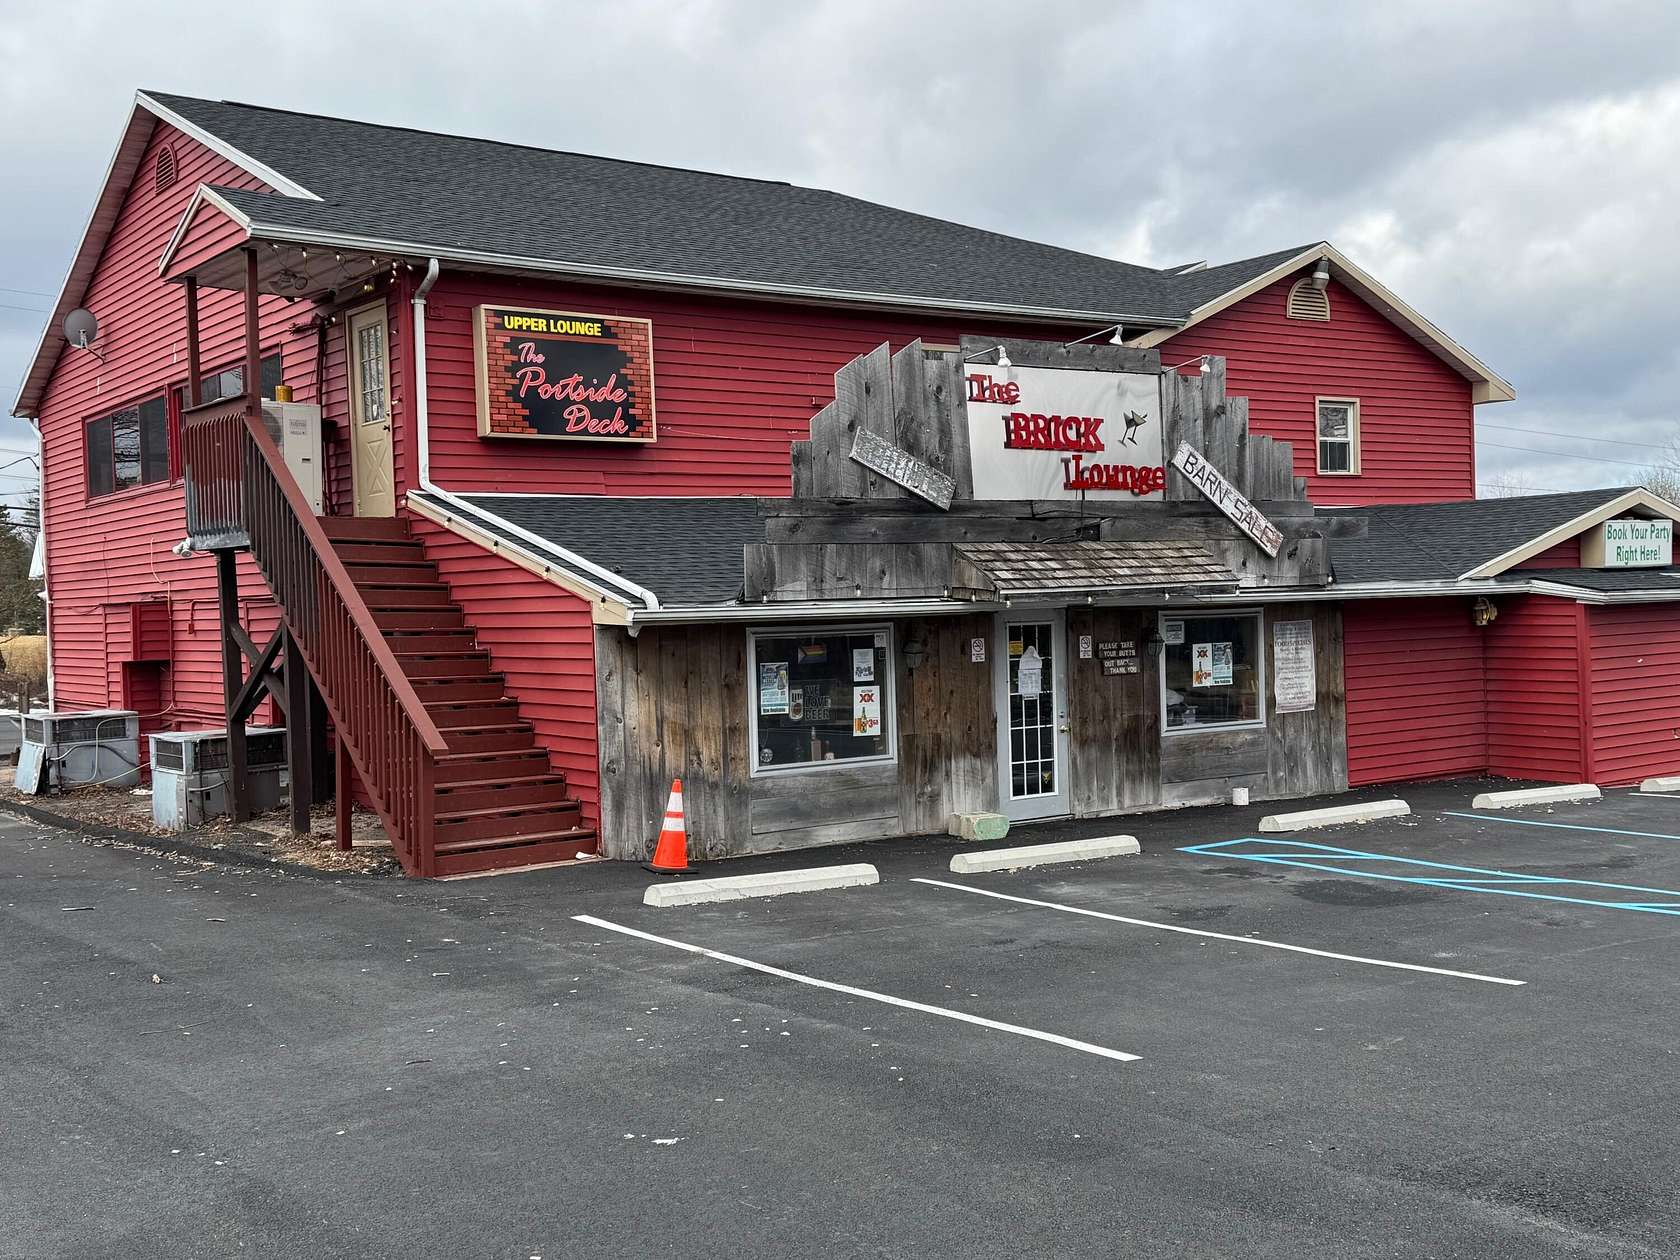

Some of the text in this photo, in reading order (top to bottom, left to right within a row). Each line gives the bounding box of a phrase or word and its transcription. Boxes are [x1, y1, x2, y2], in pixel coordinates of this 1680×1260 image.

[503, 315, 602, 336] UPPER LOUNGE
[518, 342, 546, 364] The
[516, 366, 628, 403] Portside
[967, 373, 1020, 403] The
[563, 404, 629, 434] Deck
[1005, 412, 1104, 451] BRICK
[1070, 455, 1167, 496] Lounge
[1183, 452, 1275, 548] BARN SALE
[1607, 523, 1671, 543] Book Your Party
[1616, 545, 1661, 565] Right Here!
[1099, 642, 1118, 650] PLEASE
[1119, 649, 1136, 657] BUTTS
[1110, 665, 1137, 674] THANK YOU
